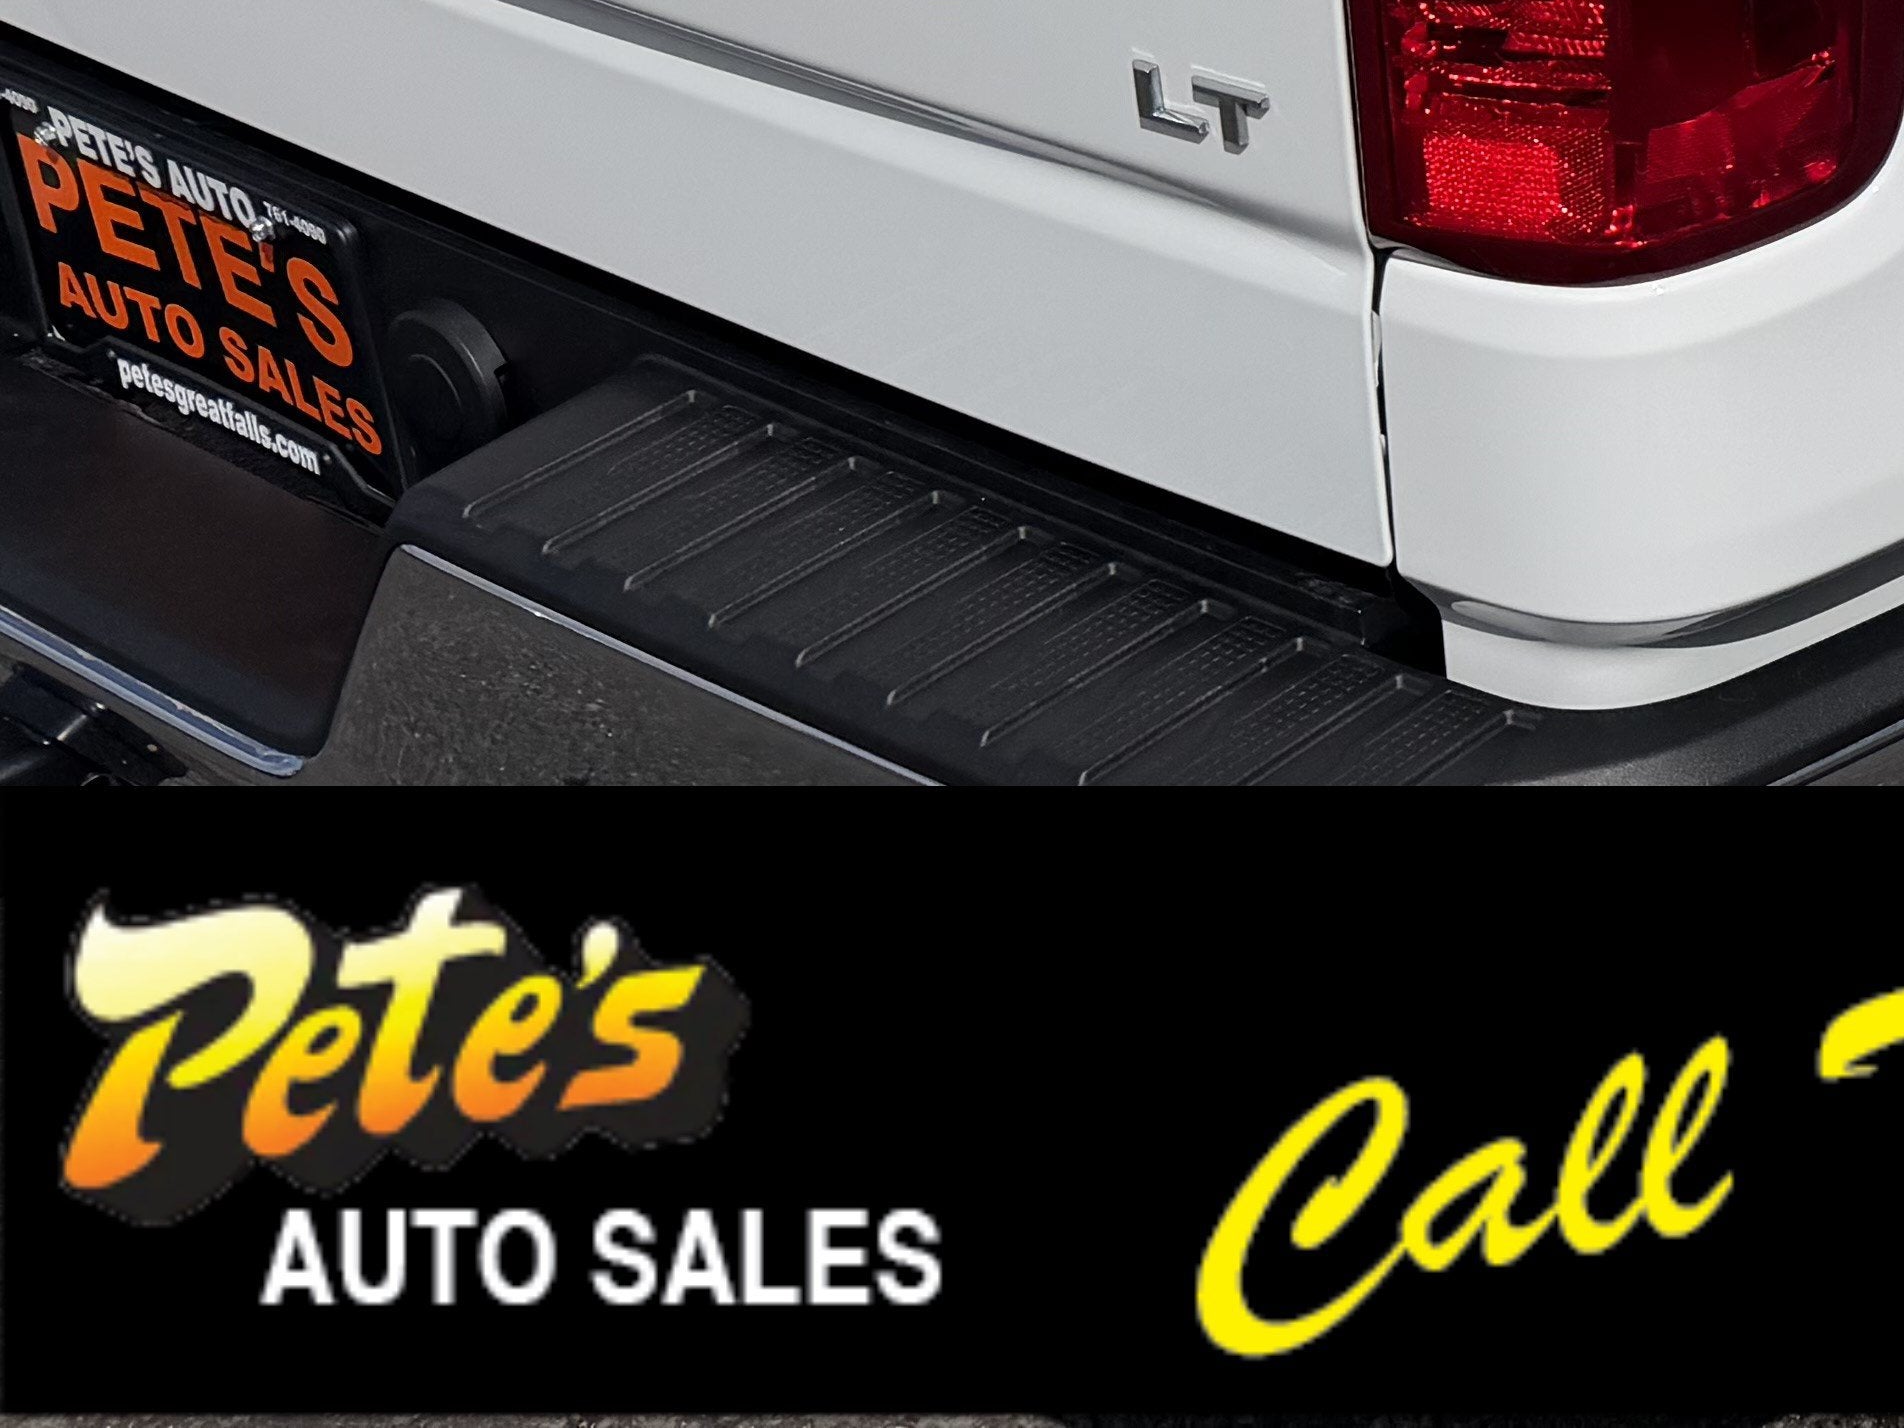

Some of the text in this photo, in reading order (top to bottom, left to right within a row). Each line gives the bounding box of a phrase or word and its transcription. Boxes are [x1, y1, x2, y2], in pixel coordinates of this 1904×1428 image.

[47, 105, 257, 225] PETE'S AUTO
[1132, 59, 1271, 155] LT
[16, 132, 353, 368] PETE'S
[262, 201, 327, 245] 761-4090
[57, 261, 383, 455] AUTO SALES
[116, 357, 321, 476] petesgreatfalls.com
